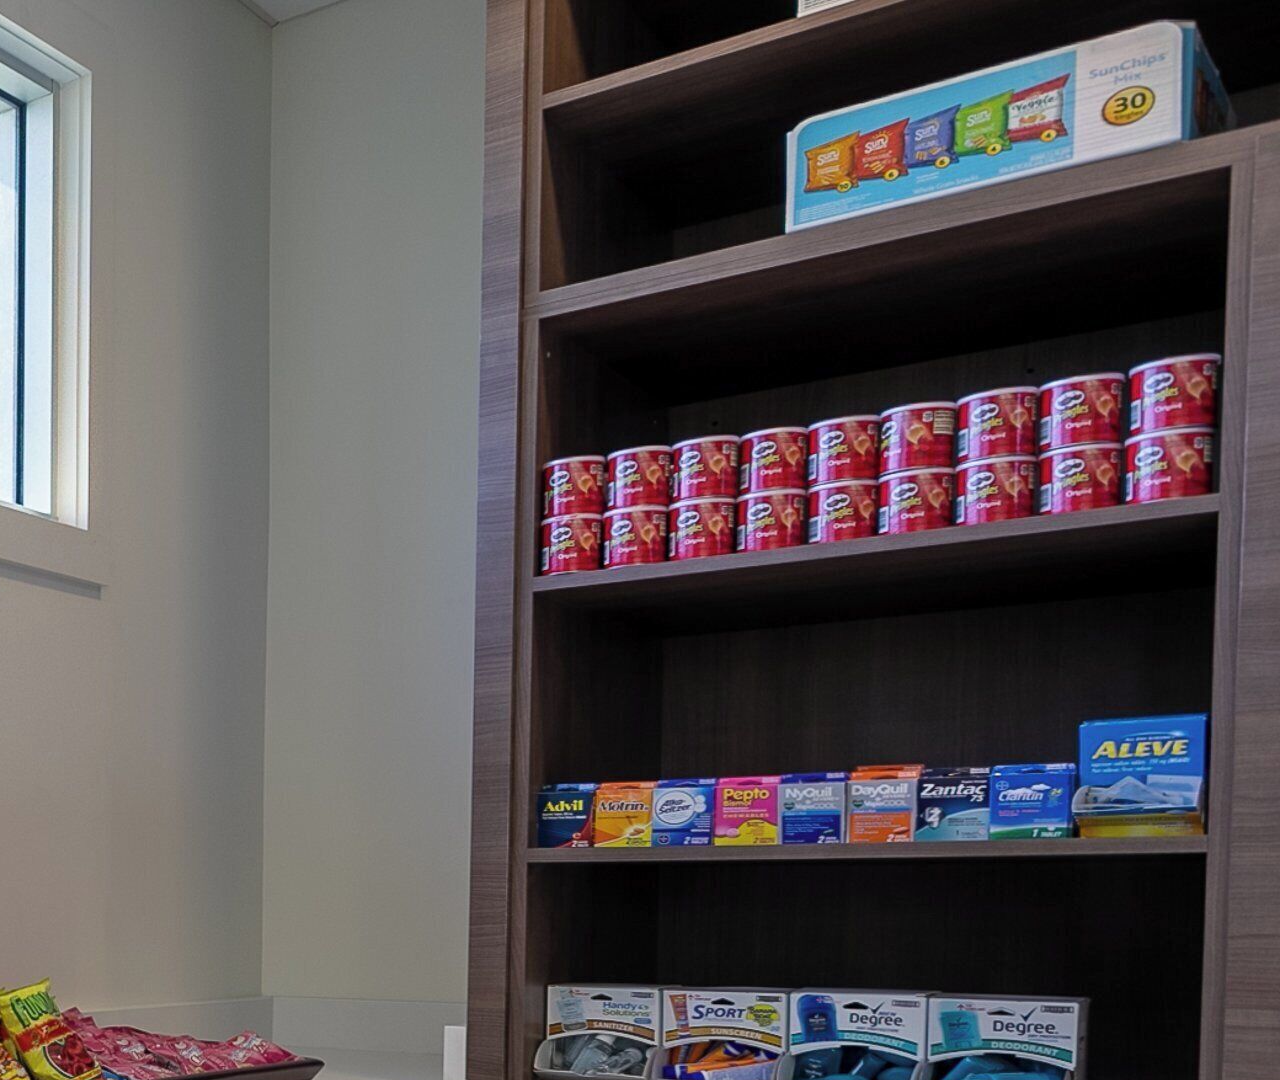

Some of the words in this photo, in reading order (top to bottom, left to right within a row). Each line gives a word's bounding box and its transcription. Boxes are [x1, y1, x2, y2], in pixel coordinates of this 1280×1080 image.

[1089, 53, 1167, 80] SunChips
[1113, 92, 1147, 115] 30
[1091, 739, 1189, 760] ALEVE
[723, 788, 770, 803] Pepto
[785, 787, 833, 799] NyQuil
[851, 784, 909, 800] DayQuil
[920, 783, 987, 797] Zantac
[998, 790, 1044, 802] Claritin
[970, 794, 984, 803] 75
[543, 800, 584, 812] Advil
[599, 801, 644, 813] Motrin
[658, 804, 692, 815] Seltzer
[603, 1002, 637, 1011] Handy
[692, 1004, 747, 1020] SPORT
[592, 1021, 635, 1032] SANITIZER
[849, 1012, 903, 1027] Degree
[711, 1028, 761, 1040] SUNSCREEN
[993, 1020, 1056, 1036] Degree
[991, 1041, 1059, 1057] DEODORANT
